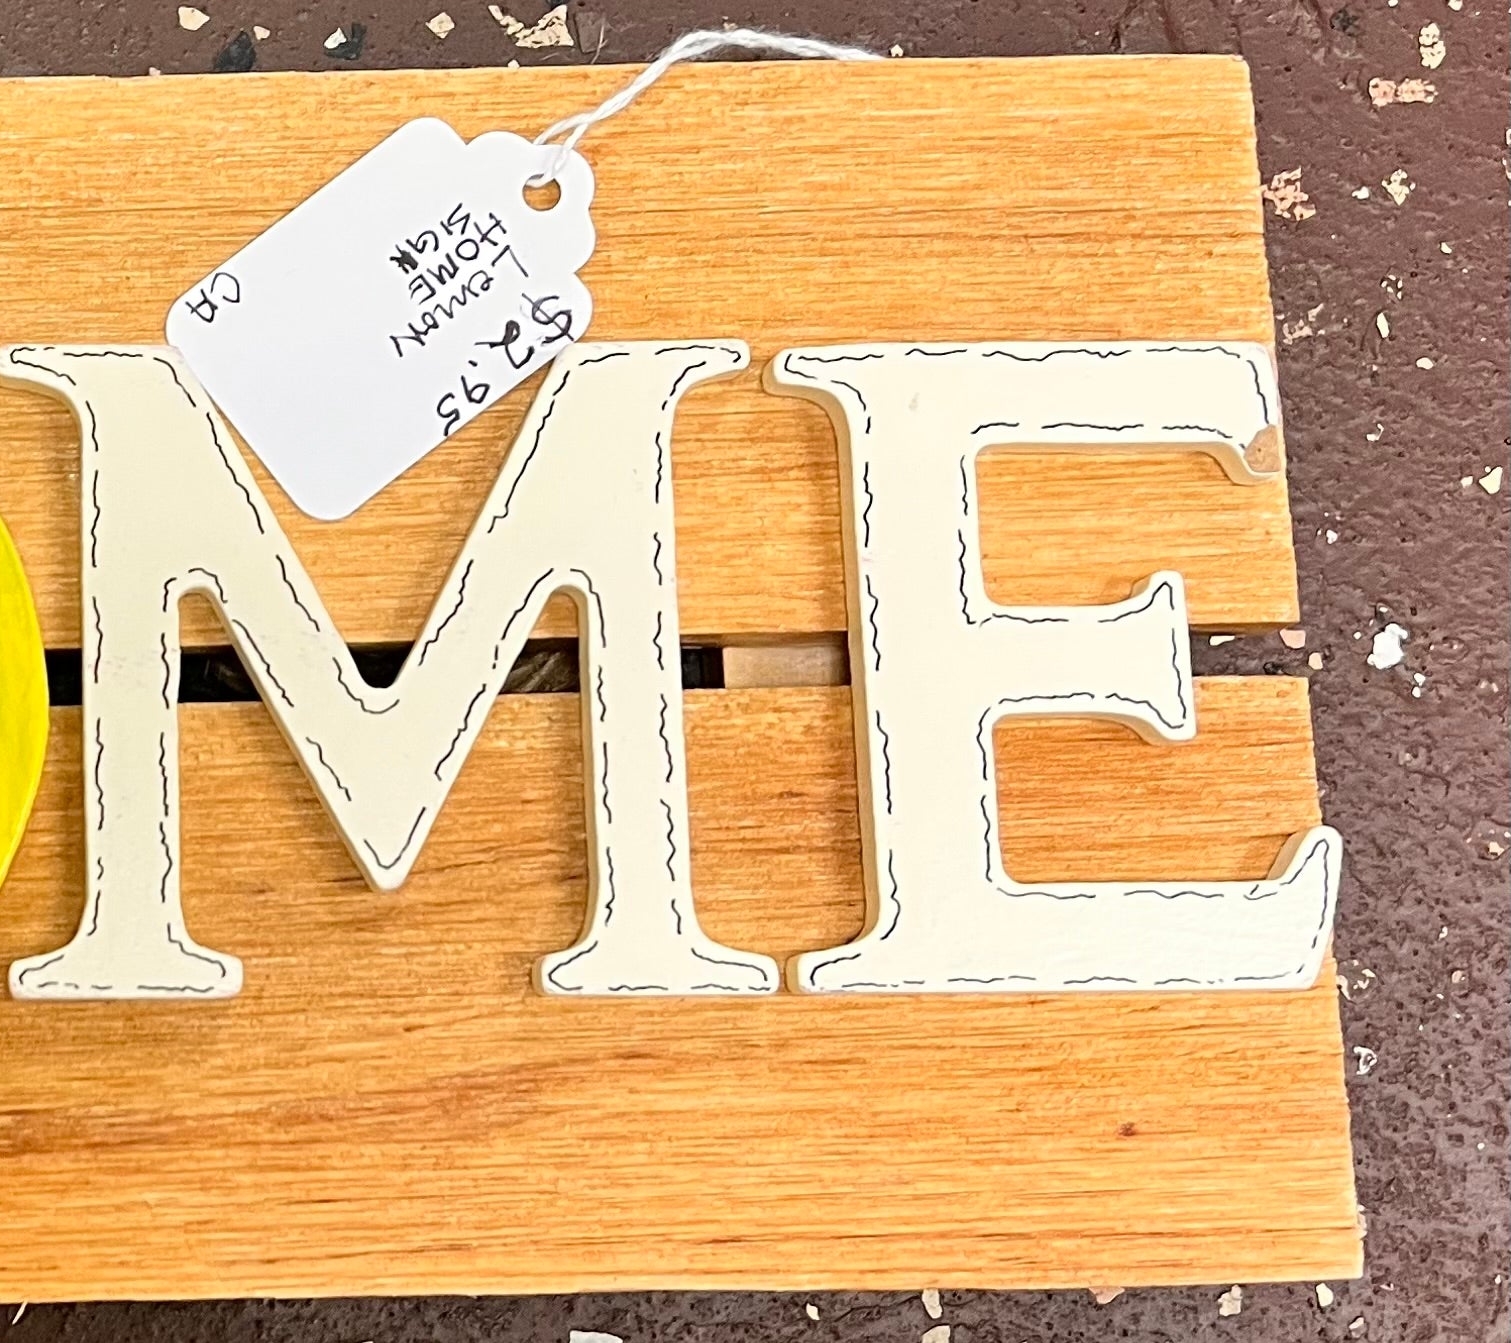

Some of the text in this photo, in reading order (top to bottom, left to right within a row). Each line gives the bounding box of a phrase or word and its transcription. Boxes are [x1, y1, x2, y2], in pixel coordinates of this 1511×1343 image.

[184, 271, 241, 324] CA
[409, 212, 508, 306] HOME
[436, 291, 576, 437] $2.95
